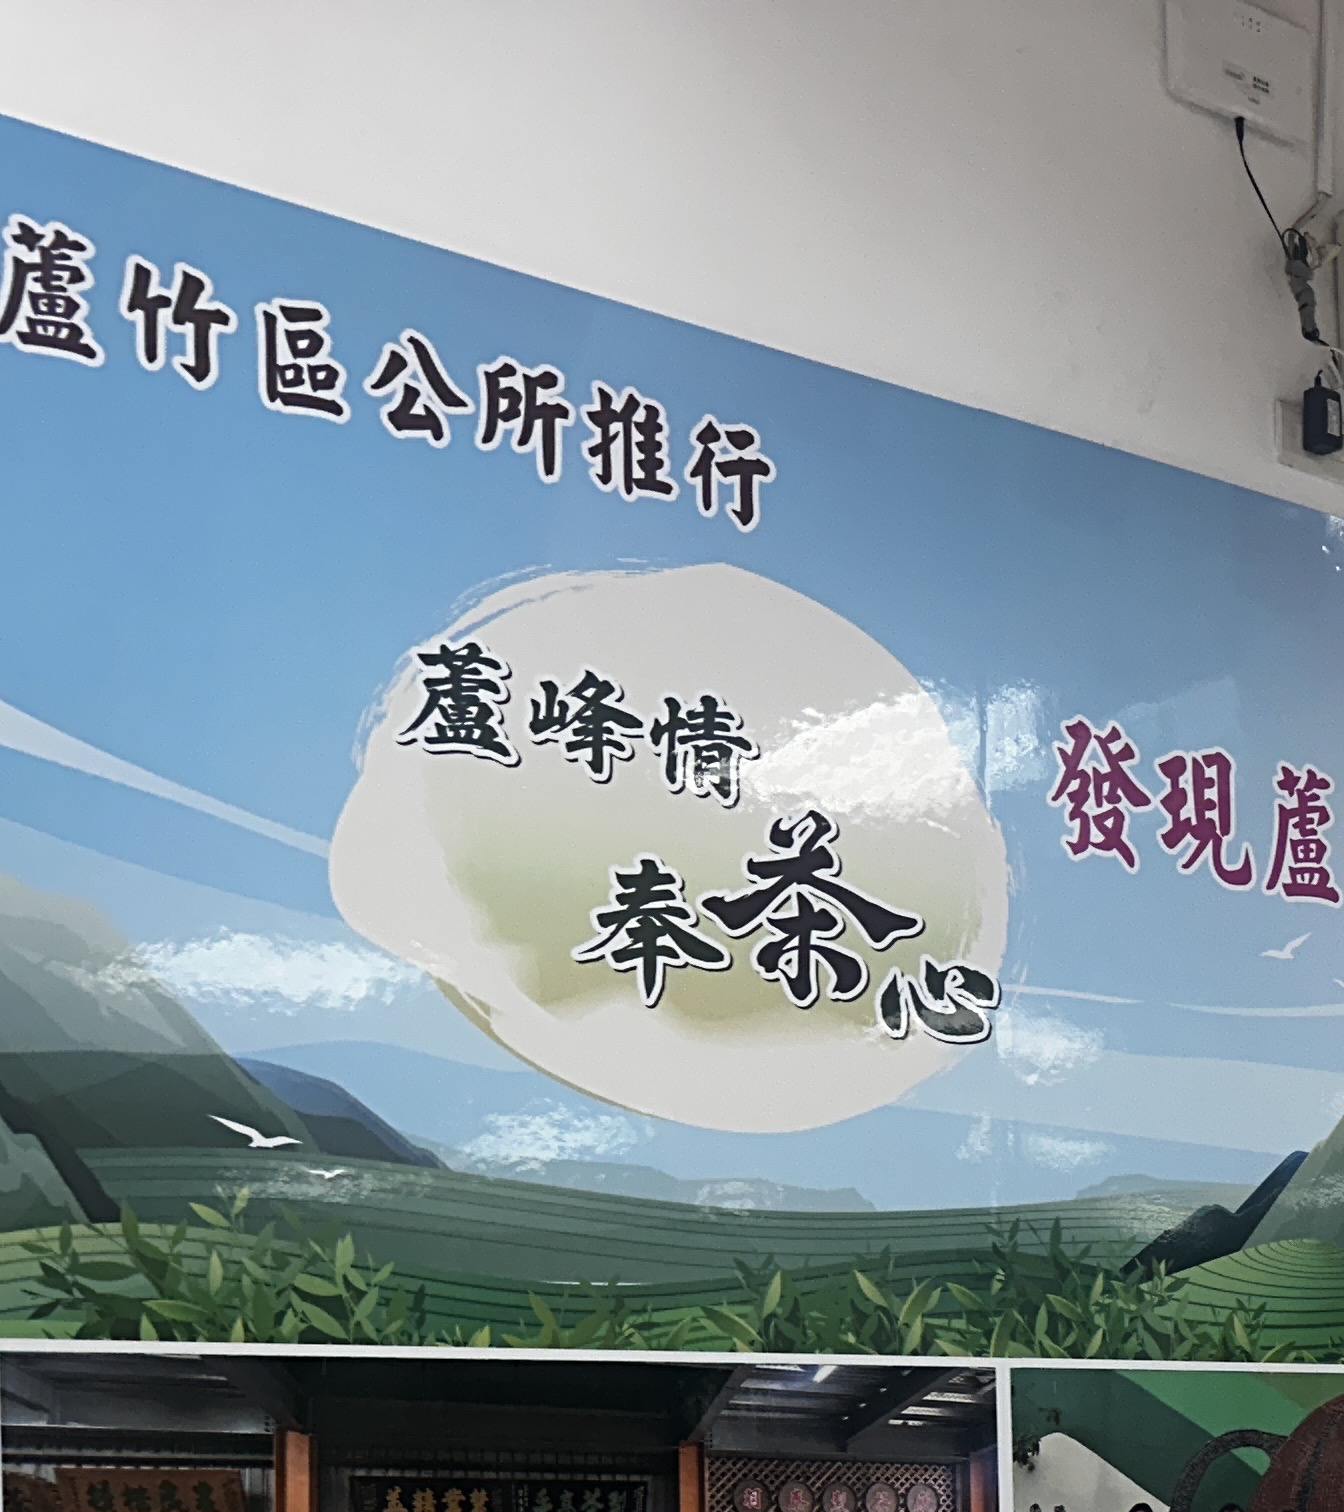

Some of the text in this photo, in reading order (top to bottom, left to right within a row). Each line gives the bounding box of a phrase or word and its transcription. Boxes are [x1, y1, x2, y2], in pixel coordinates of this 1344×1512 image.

[0, 218, 773, 530] 蘆竹區公所推行
[402, 642, 758, 803] 蘆峰情
[576, 811, 999, 1042] 奉茶心
